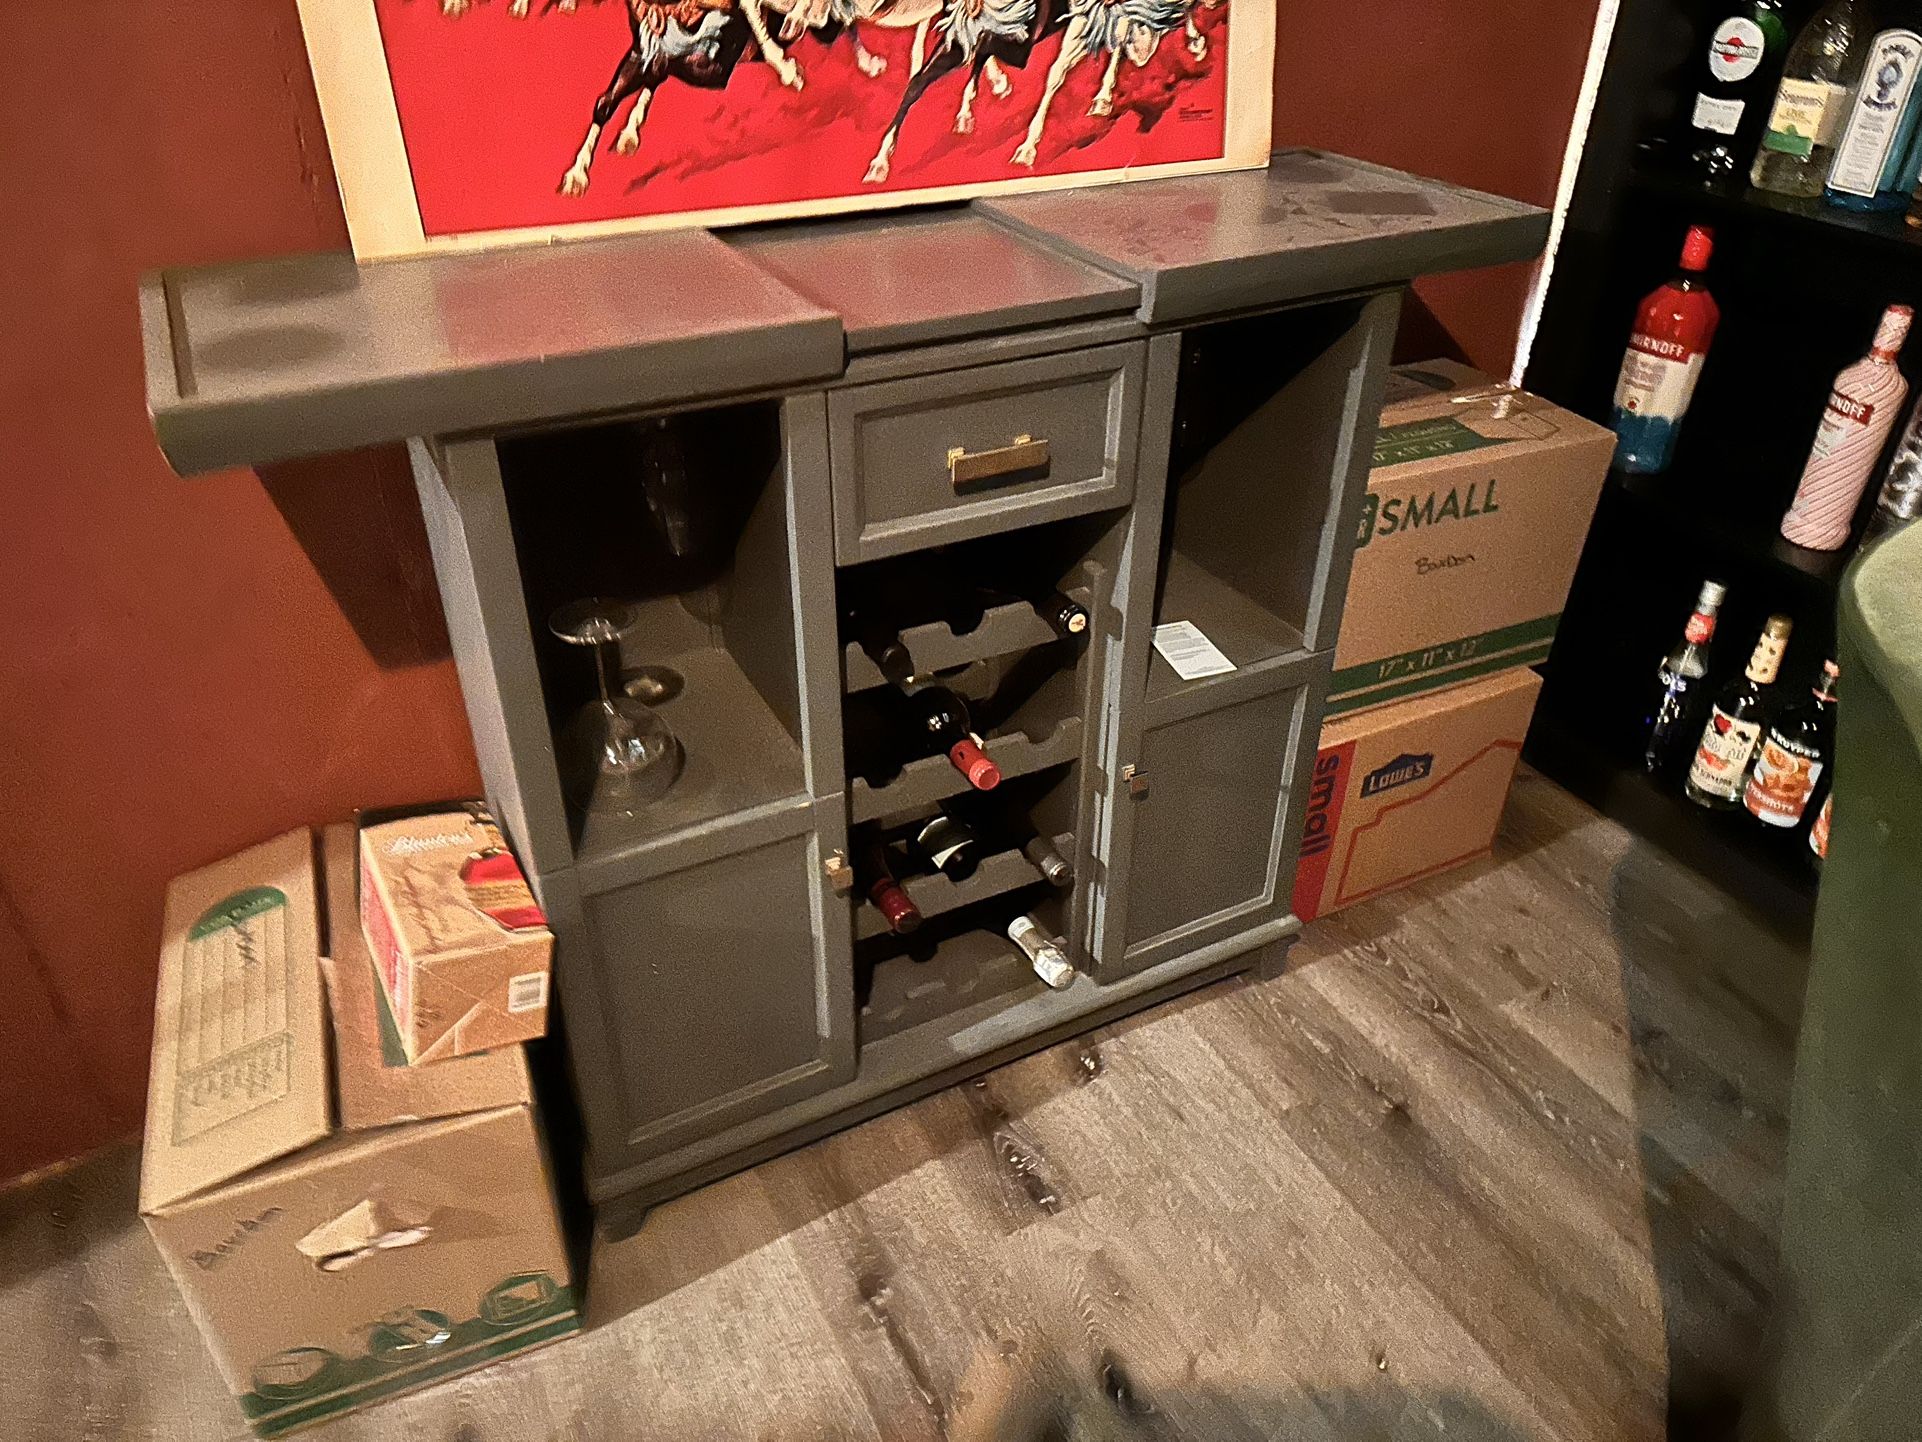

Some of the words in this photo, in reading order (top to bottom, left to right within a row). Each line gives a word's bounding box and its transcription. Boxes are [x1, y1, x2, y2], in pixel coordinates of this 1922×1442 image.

[1378, 478, 1499, 536] SMALL
[1378, 659, 1403, 679] 17"
[1406, 661, 1415, 671] x
[1446, 650, 1455, 661] x
[1298, 754, 1340, 858] small
